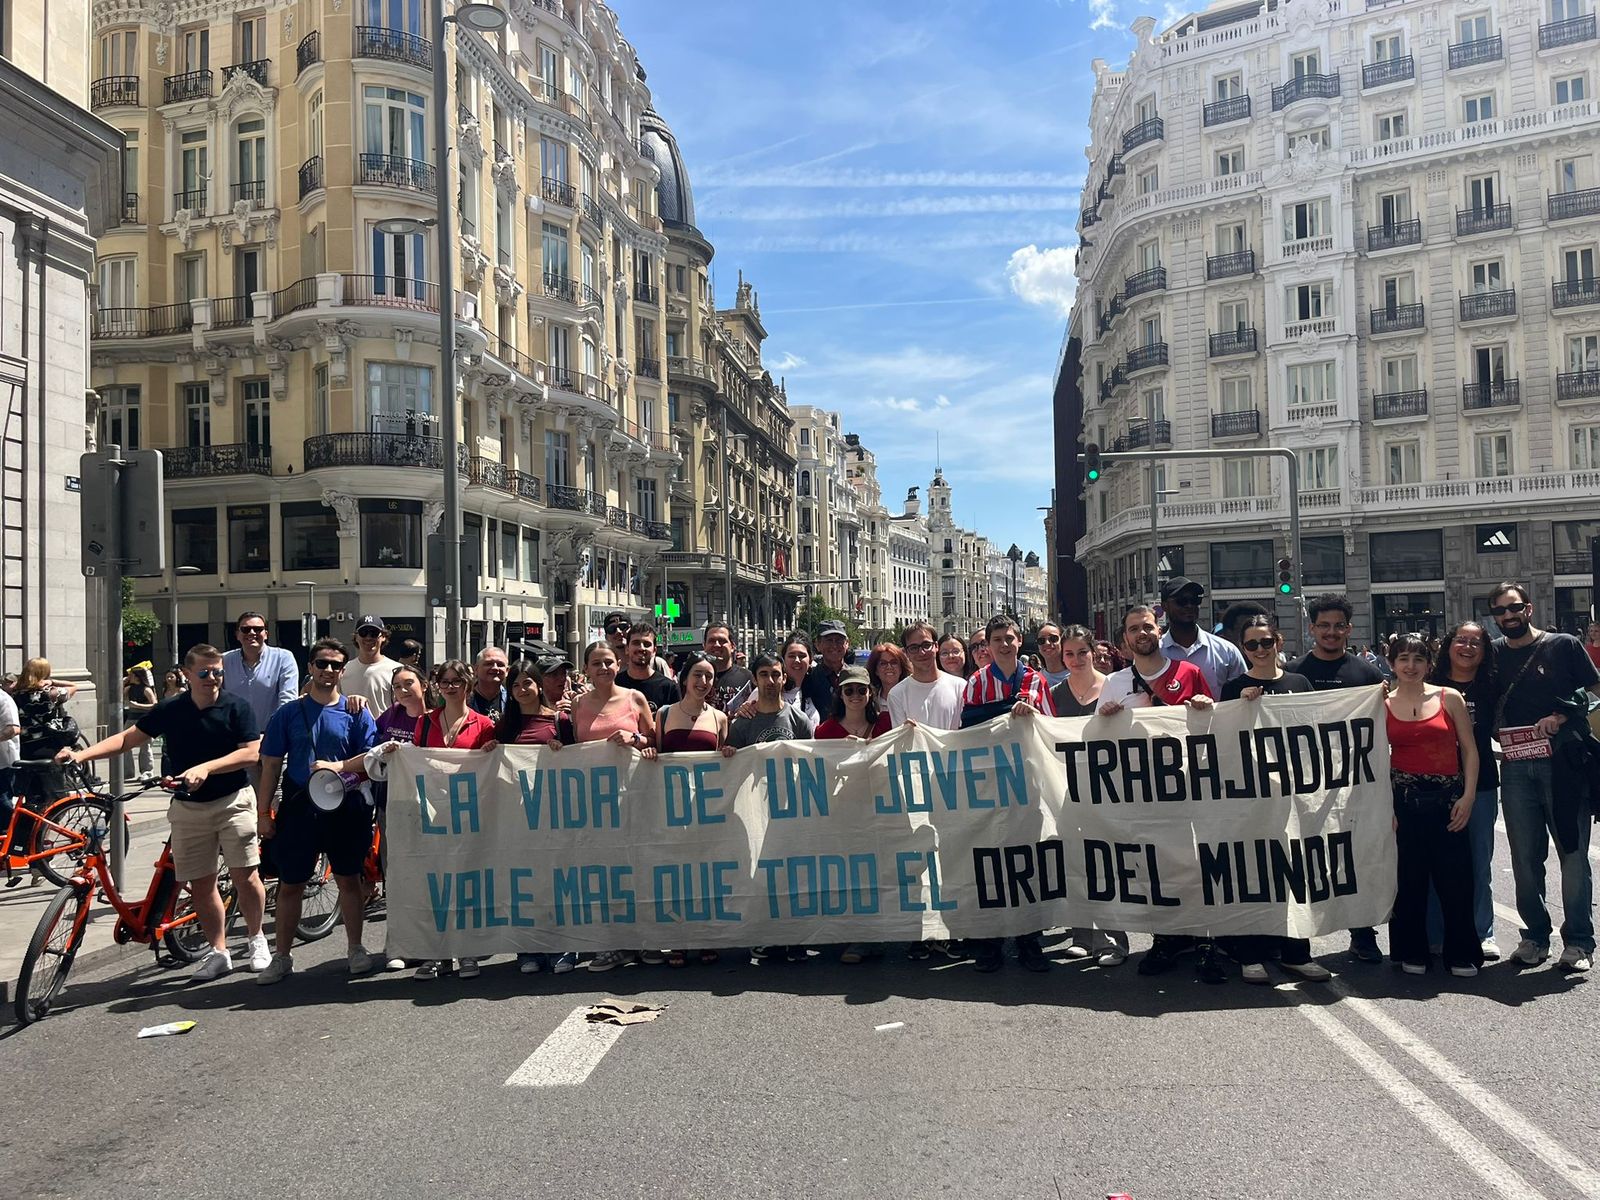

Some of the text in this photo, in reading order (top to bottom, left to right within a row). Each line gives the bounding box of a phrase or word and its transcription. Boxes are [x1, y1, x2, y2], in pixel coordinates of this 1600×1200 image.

[416, 717, 1376, 836] LA VIDA DE UN JOVEN TRABAJADOR
[427, 830, 1358, 932] VALE MAS QUE TODO EL ORO DEL MUNDO
